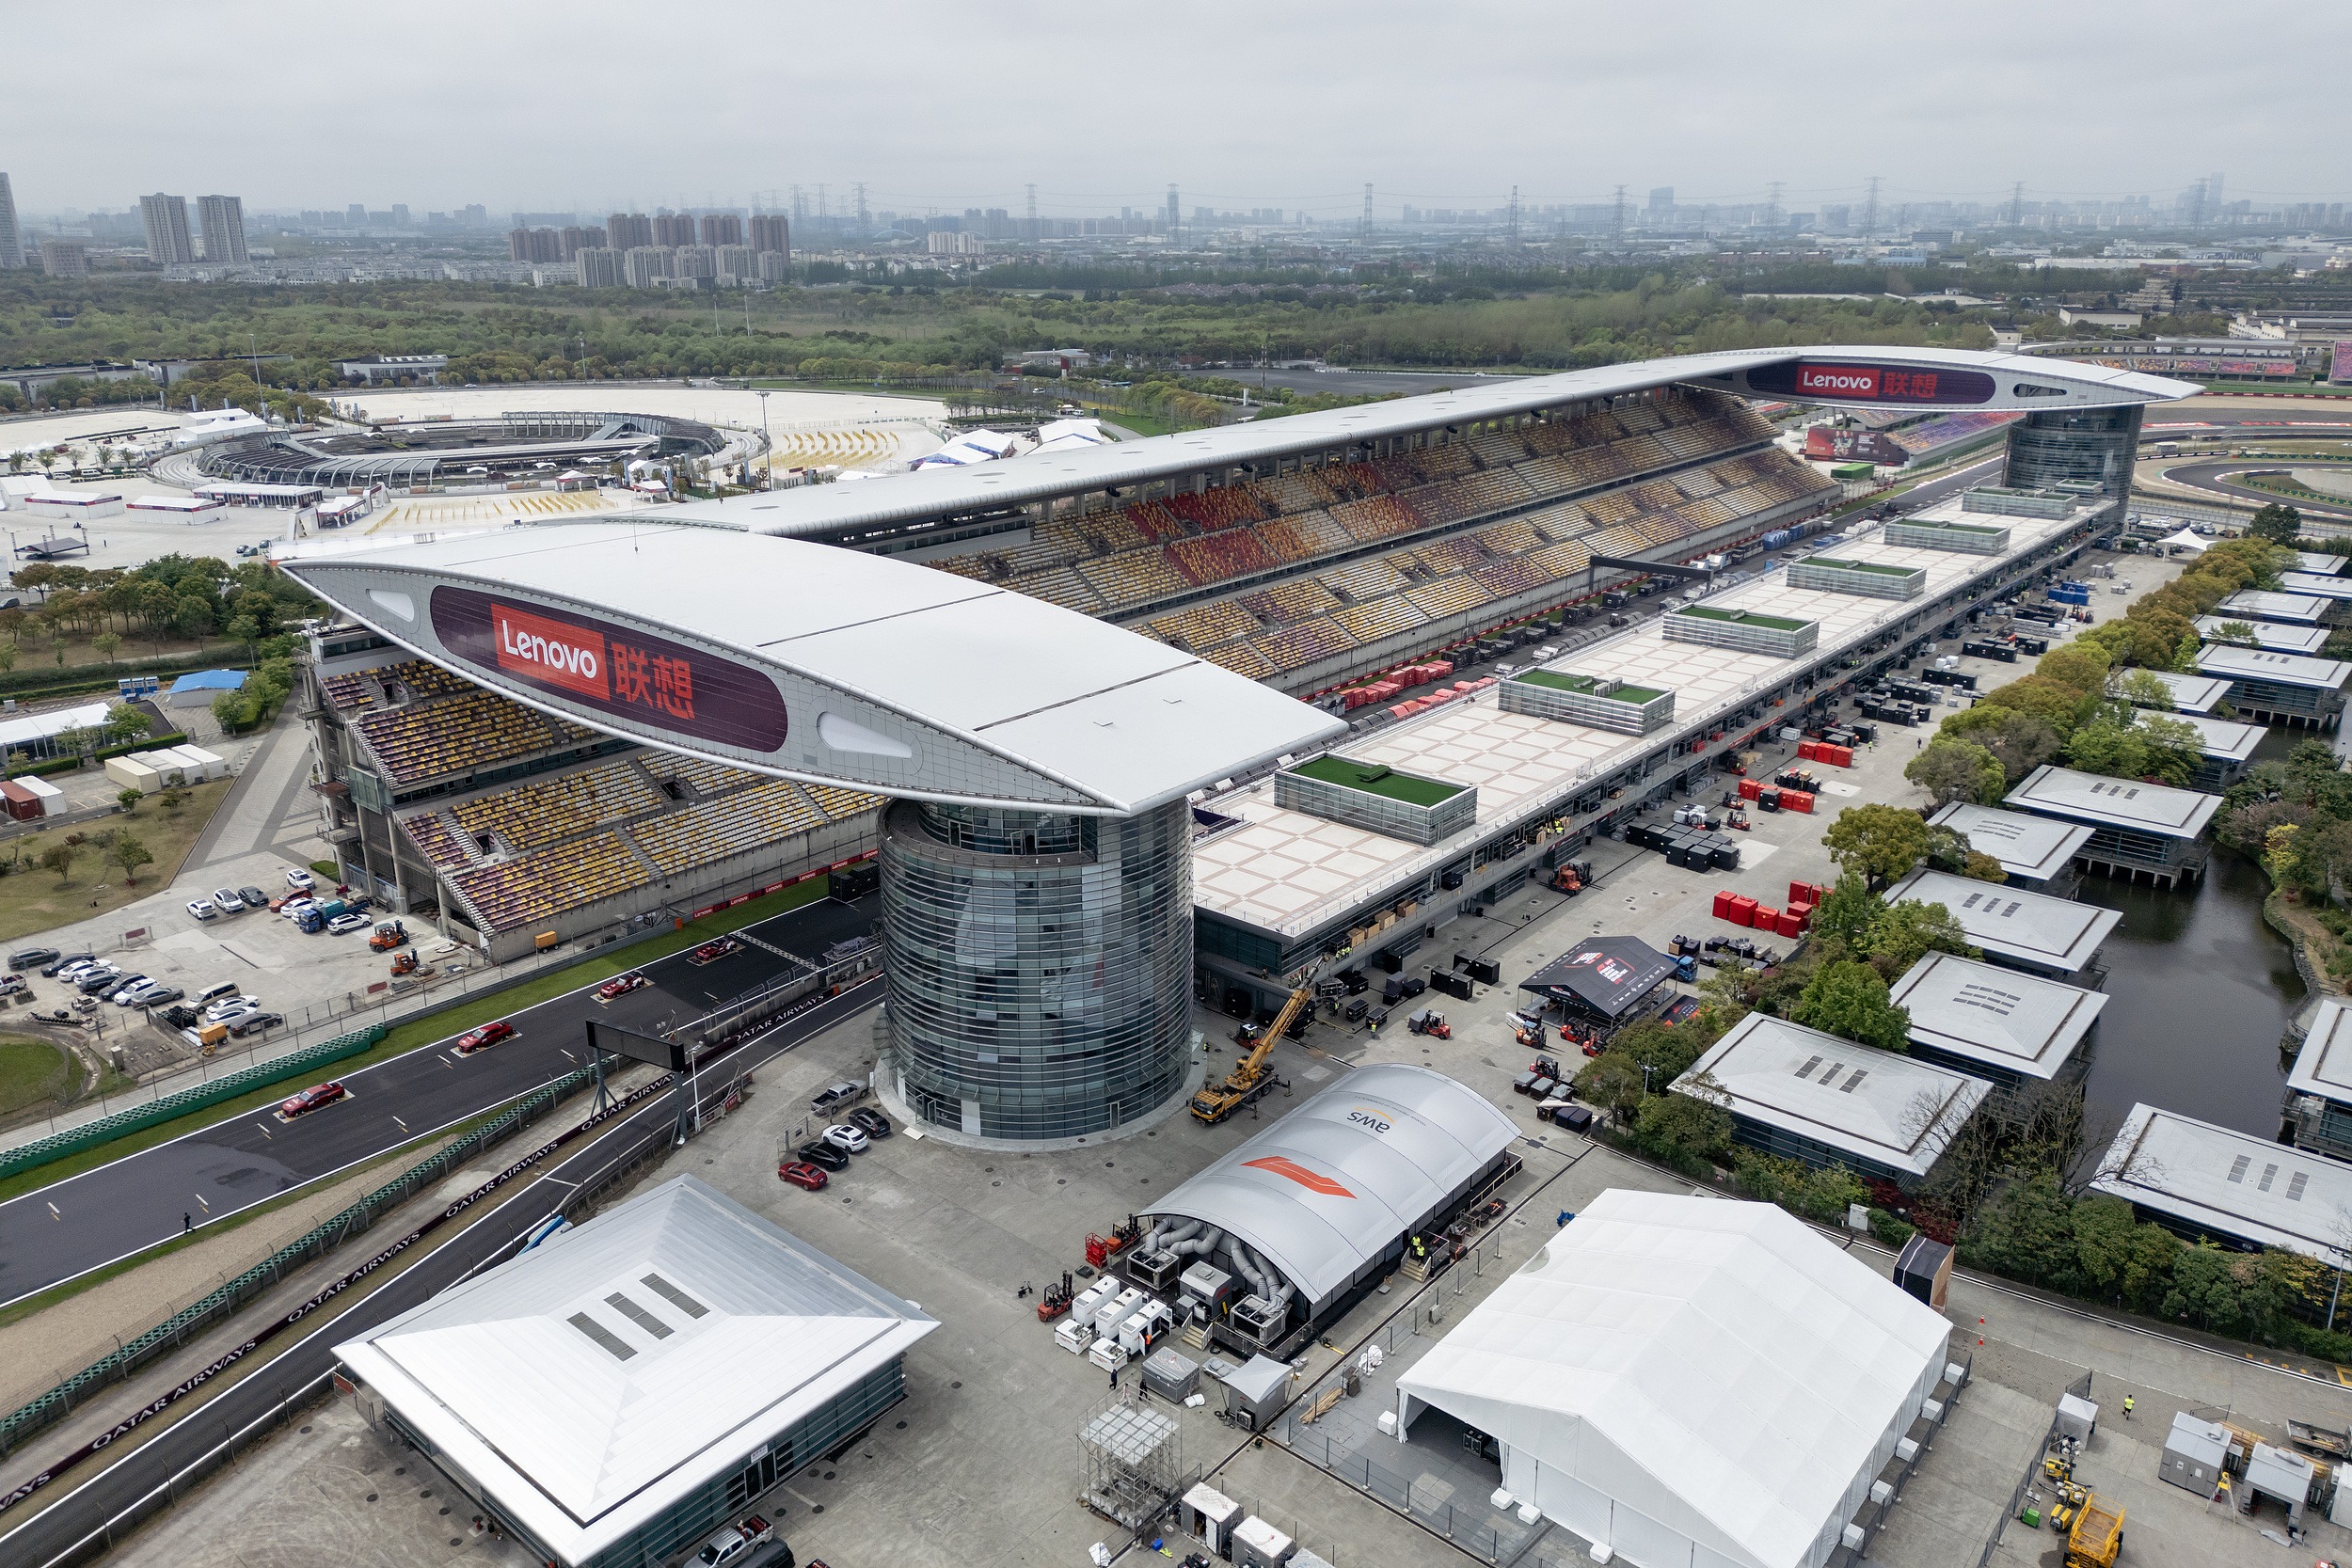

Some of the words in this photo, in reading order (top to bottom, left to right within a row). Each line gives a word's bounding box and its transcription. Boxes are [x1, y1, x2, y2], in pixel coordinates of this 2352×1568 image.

[1803, 371, 1872, 390] Lenovo
[1883, 372, 1938, 398] 联想
[501, 619, 597, 679] Lenovo
[612, 641, 695, 721] 联想
[775, 993, 825, 1022] AIRWAYS
[580, 1100, 628, 1132] QATAR
[629, 1072, 675, 1104] AIRWAY
[1346, 1111, 1391, 1134] aws
[445, 1180, 497, 1218] QATAR
[498, 1140, 559, 1183] AIRWAYS
[288, 1279, 348, 1323] QATAR
[352, 1230, 421, 1283] AIRWAYS
[92, 1398, 168, 1450] QATAR
[172, 1339, 257, 1401] AIRWAYS
